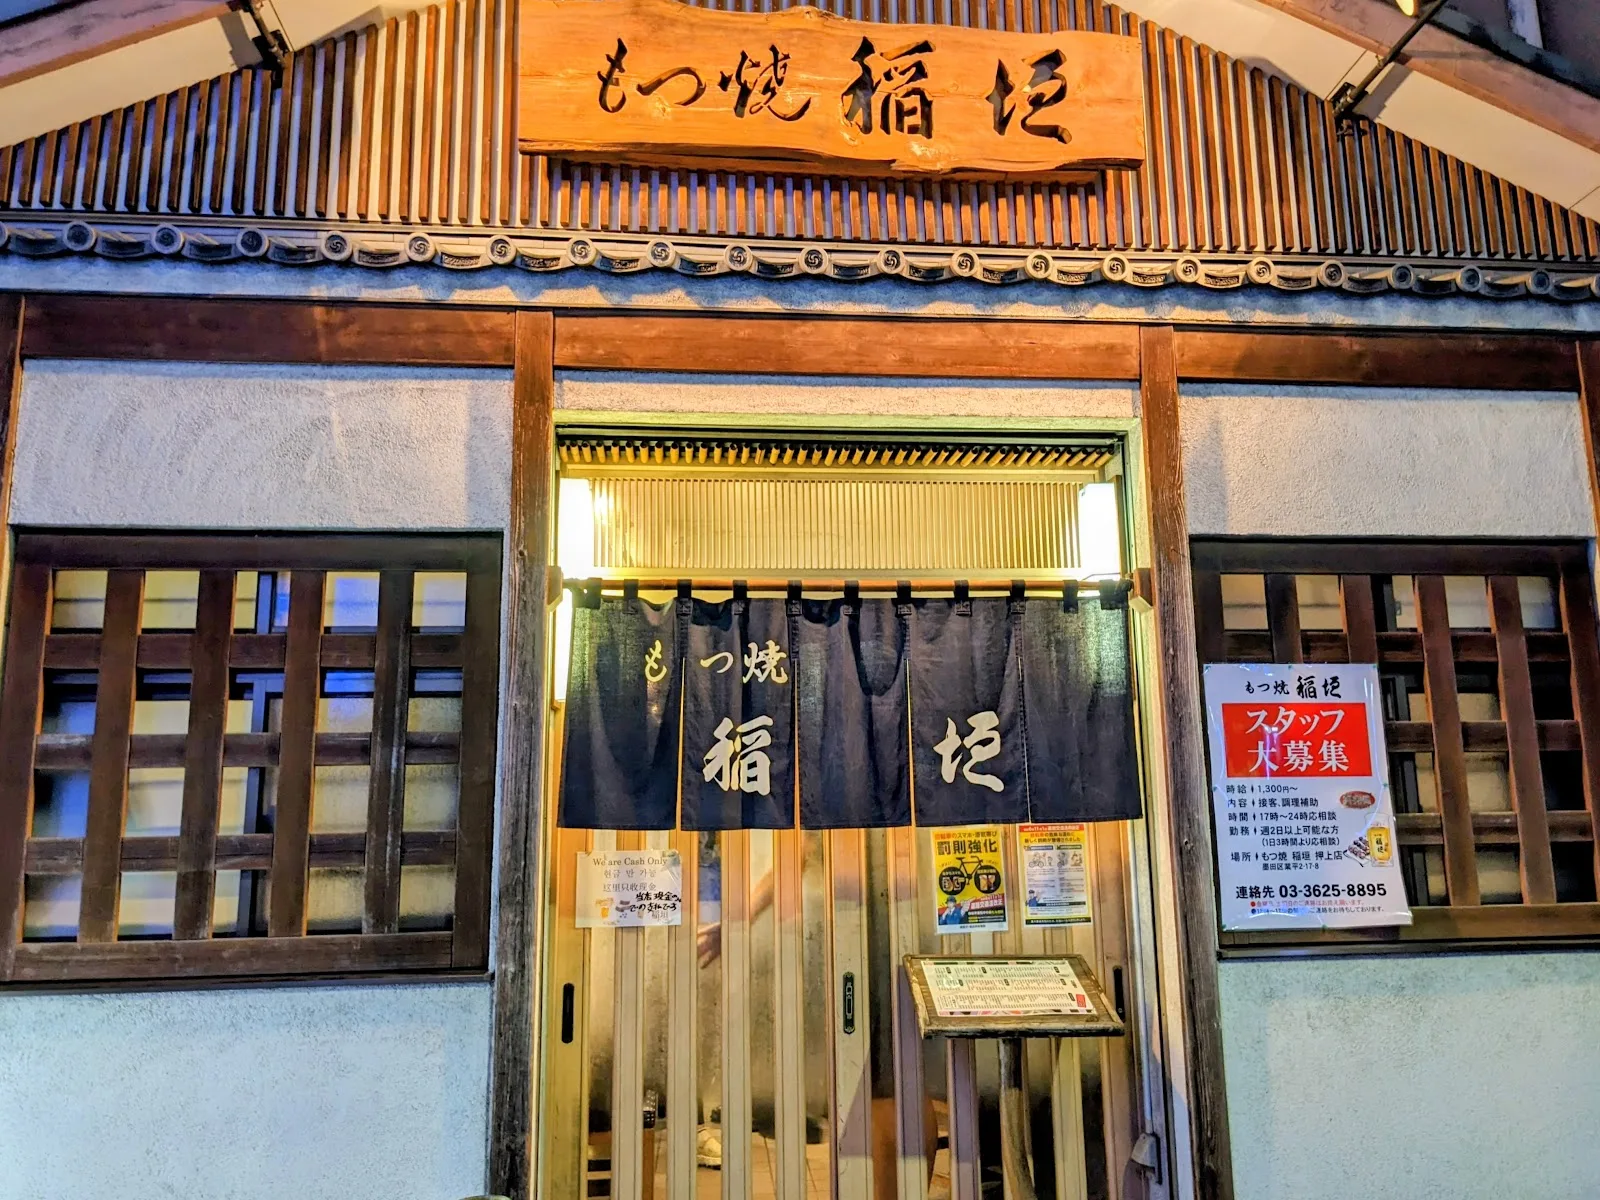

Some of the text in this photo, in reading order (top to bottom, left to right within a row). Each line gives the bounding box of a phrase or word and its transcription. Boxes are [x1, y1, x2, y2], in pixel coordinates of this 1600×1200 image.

[598, 36, 1073, 143] もつ焼 稲垣
[644, 640, 788, 684] もつ焼
[1245, 675, 1341, 699] もつ焼 稲垣
[1245, 706, 1345, 736] スタッフ
[1248, 740, 1349, 773] 大募集
[1226, 784, 1247, 794] 時給
[1228, 798, 1319, 808] 内容 接客、調理補助
[1228, 812, 1248, 822] 時間
[1229, 825, 1339, 836] 勤務 週2日以上可能な方
[937, 839, 998, 855] 罰則強化
[593, 858, 606, 866] We
[624, 857, 645, 866] Cash
[647, 857, 667, 866] Only
[1231, 851, 1343, 862] 場所 もつ焼 稲垣 押上店
[1236, 883, 1387, 899] 連絡先 03-3625-8895
